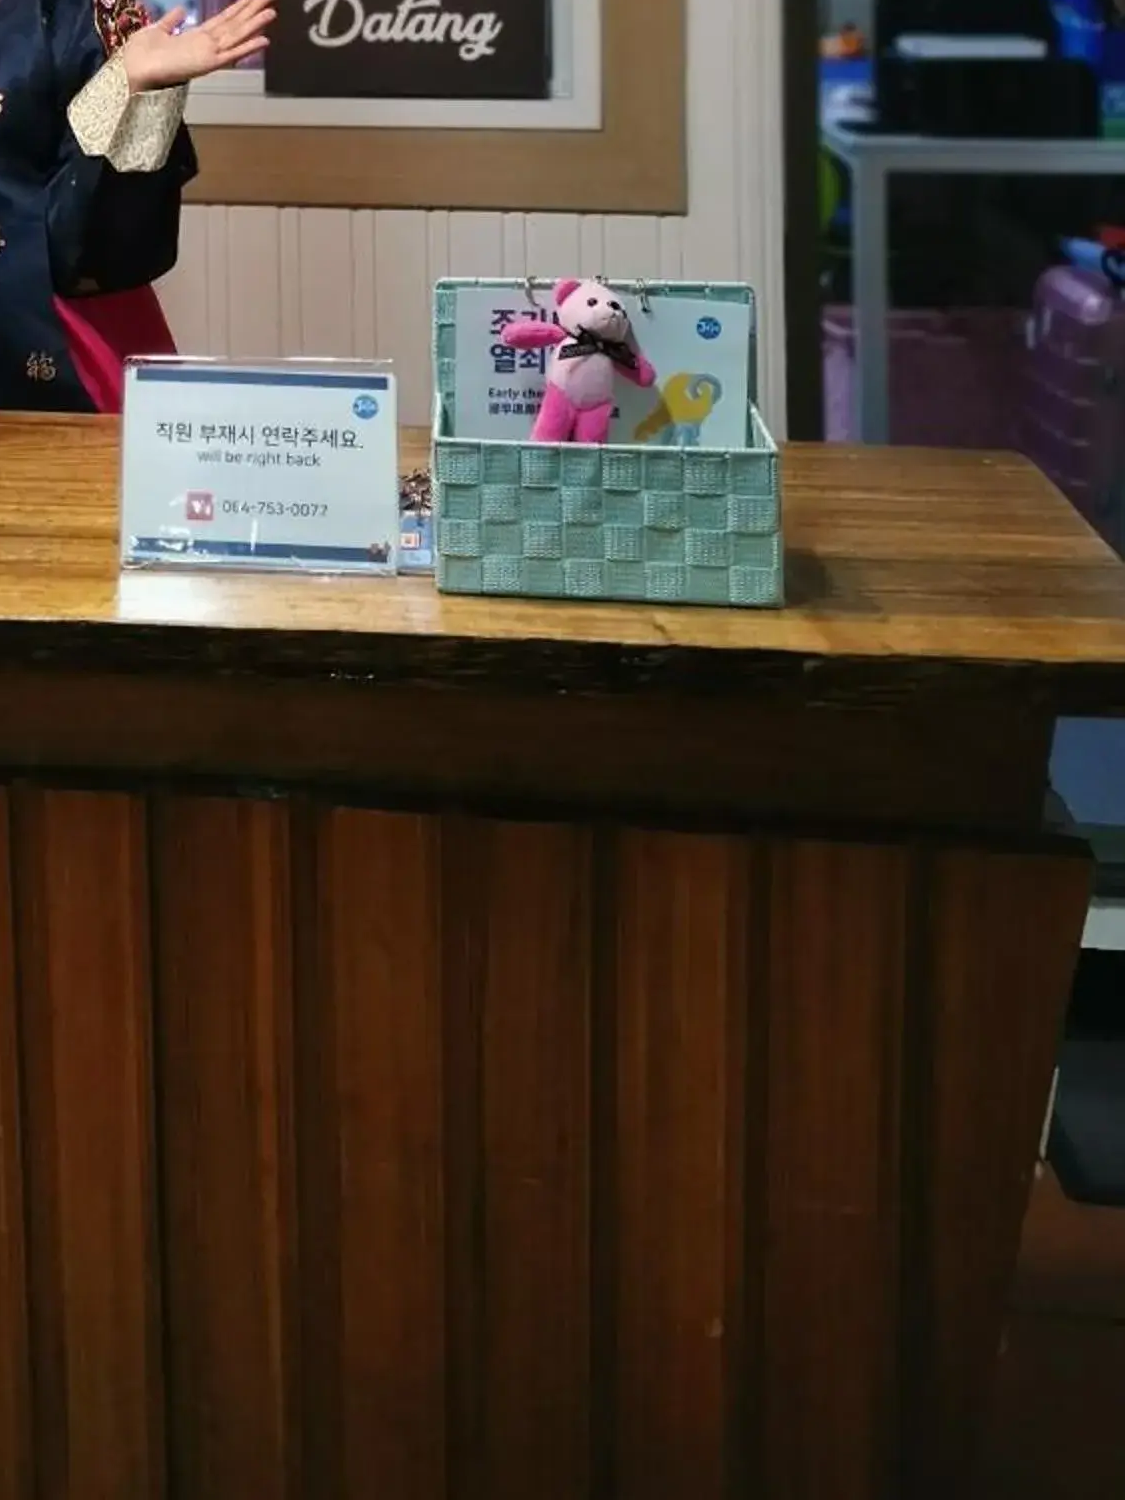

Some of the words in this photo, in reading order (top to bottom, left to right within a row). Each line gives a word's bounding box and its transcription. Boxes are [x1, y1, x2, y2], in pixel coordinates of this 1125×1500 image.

[489, 388, 520, 401] Early
[156, 422, 192, 443] 직원
[200, 424, 254, 445] 부재시
[225, 452, 243, 463] be
[246, 453, 281, 467] right
[286, 453, 321, 467] back
